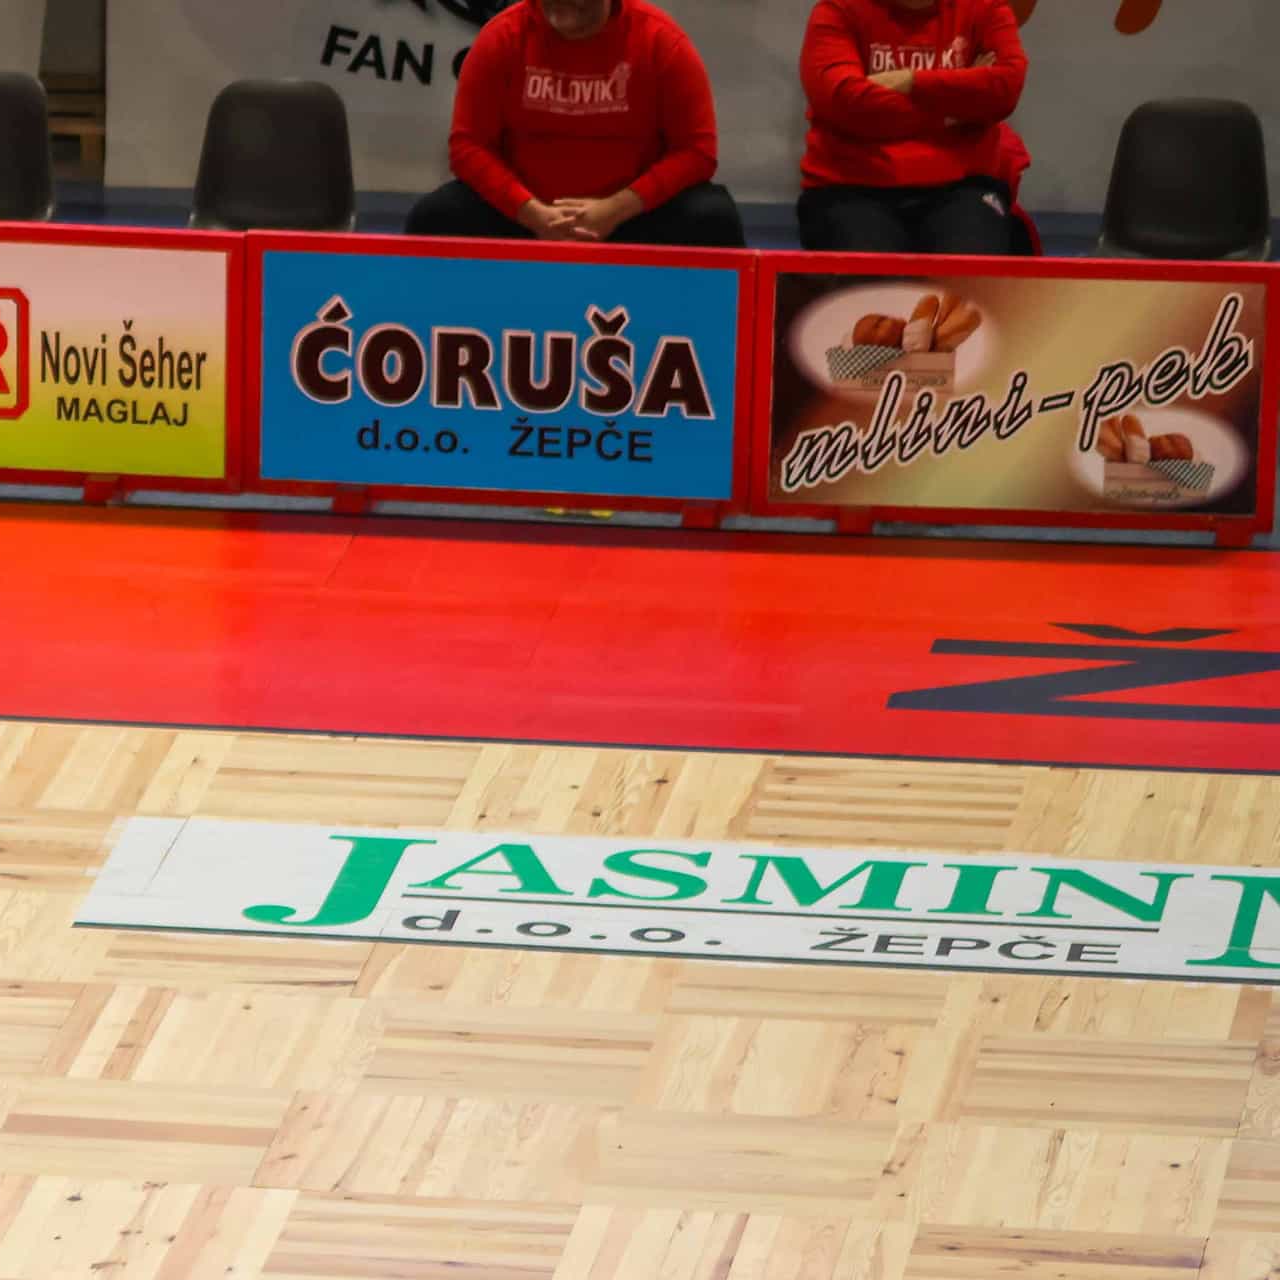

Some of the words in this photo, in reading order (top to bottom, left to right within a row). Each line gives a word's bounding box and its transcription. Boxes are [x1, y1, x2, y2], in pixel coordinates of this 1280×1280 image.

[320, 25, 434, 86] FAN
[40, 330, 108, 386] Novi
[118, 319, 207, 391] Šeher
[290, 293, 716, 420] ĆORUŠA
[55, 396, 189, 427] MAGLAJ
[780, 292, 1255, 492] mlini-pek
[356, 420, 470, 455] d.o.o.
[507, 416, 655, 463] ŽEPČE
[402, 910, 722, 947] d.o.o.
[807, 926, 1122, 964] ŽEPČE
